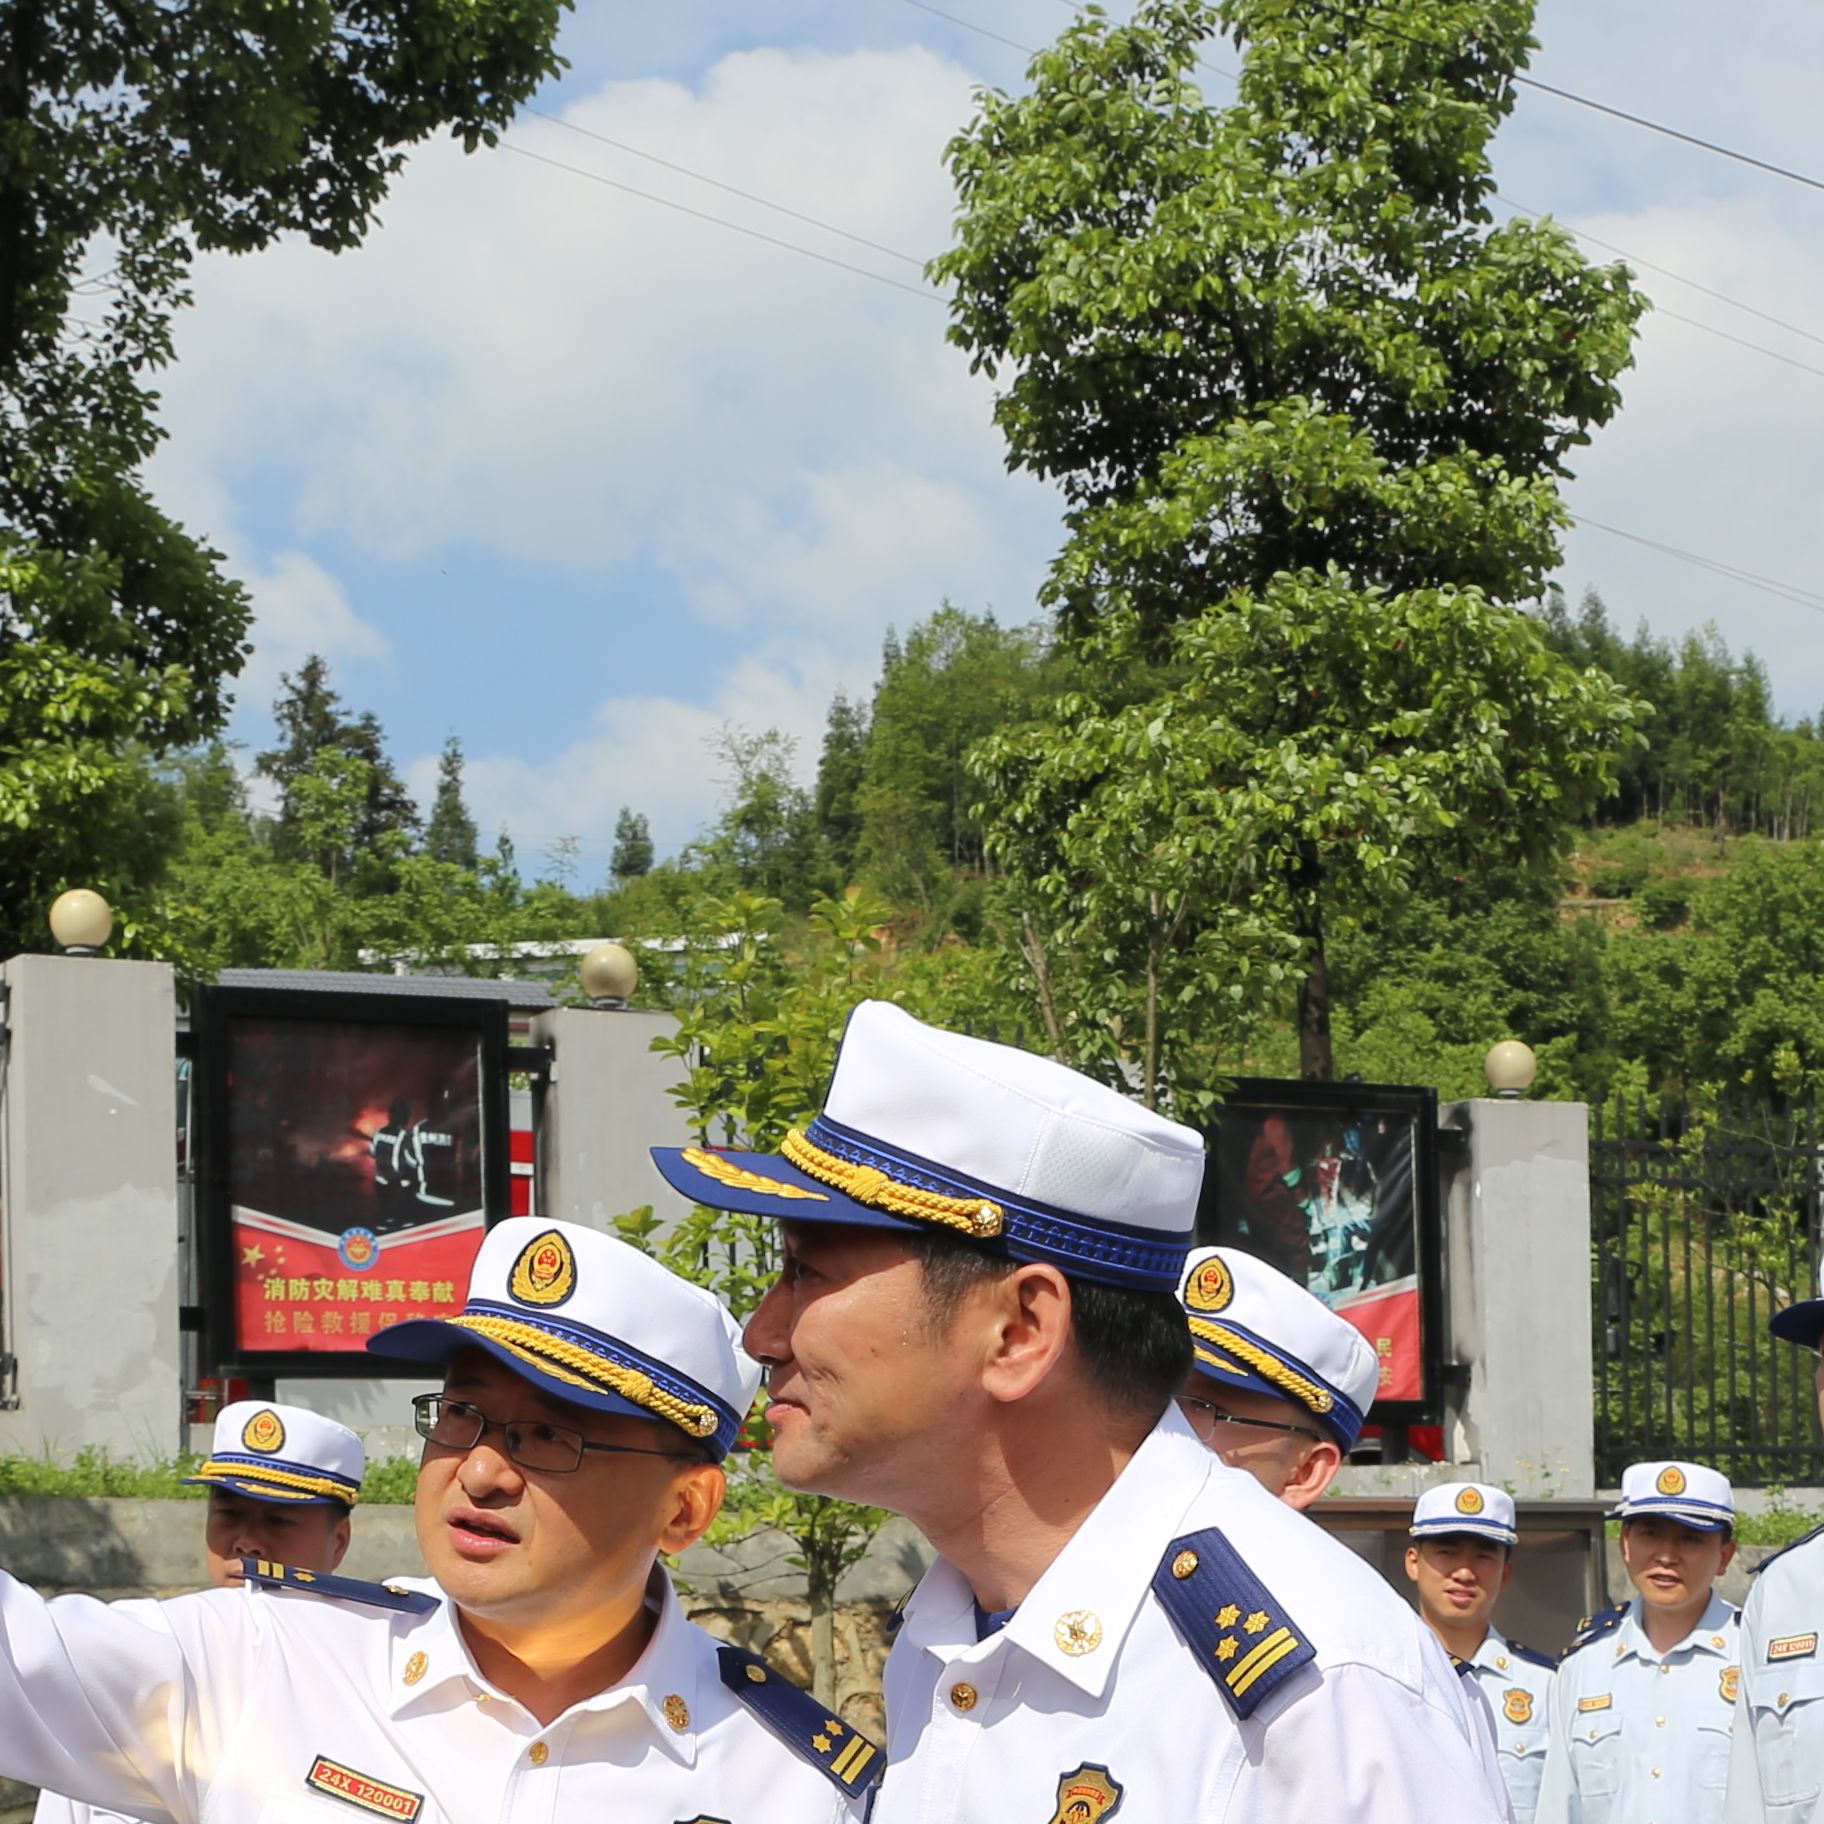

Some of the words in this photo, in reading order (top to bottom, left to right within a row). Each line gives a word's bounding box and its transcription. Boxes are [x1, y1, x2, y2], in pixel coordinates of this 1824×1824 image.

[264, 1277, 455, 1303] 消防灾解难真奉献
[318, 1768, 353, 1791] 24X
[356, 1784, 412, 1813] 120001
